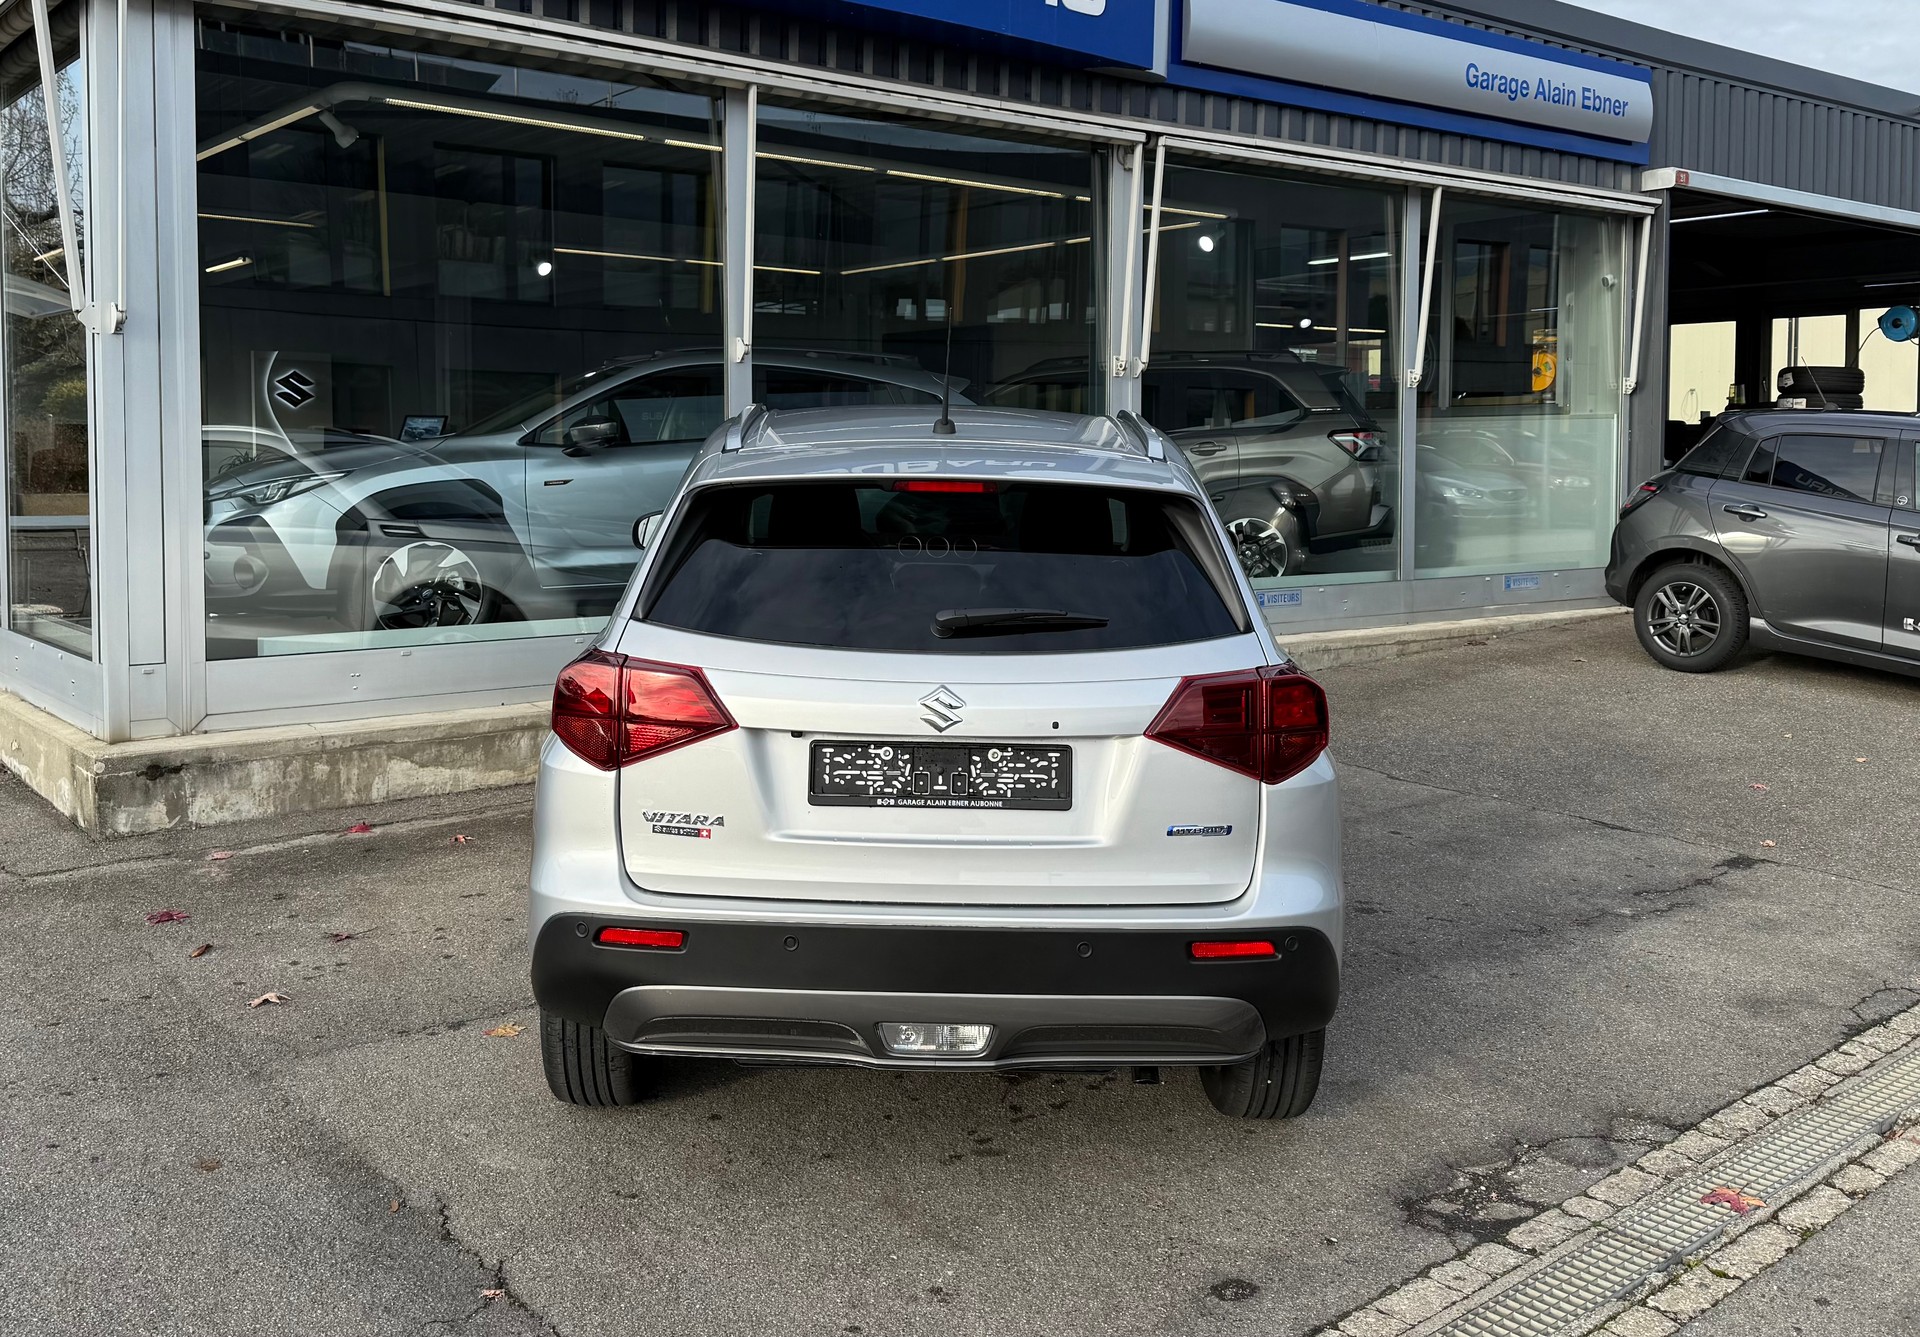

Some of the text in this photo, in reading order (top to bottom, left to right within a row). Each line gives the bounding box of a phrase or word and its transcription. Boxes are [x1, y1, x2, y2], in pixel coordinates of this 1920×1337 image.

[1466, 63, 1629, 117] Garage Alain Ebner
[1266, 593, 1300, 604] VISITEURS
[970, 800, 1003, 808] AUBONNE
[642, 811, 725, 828] VITARA
